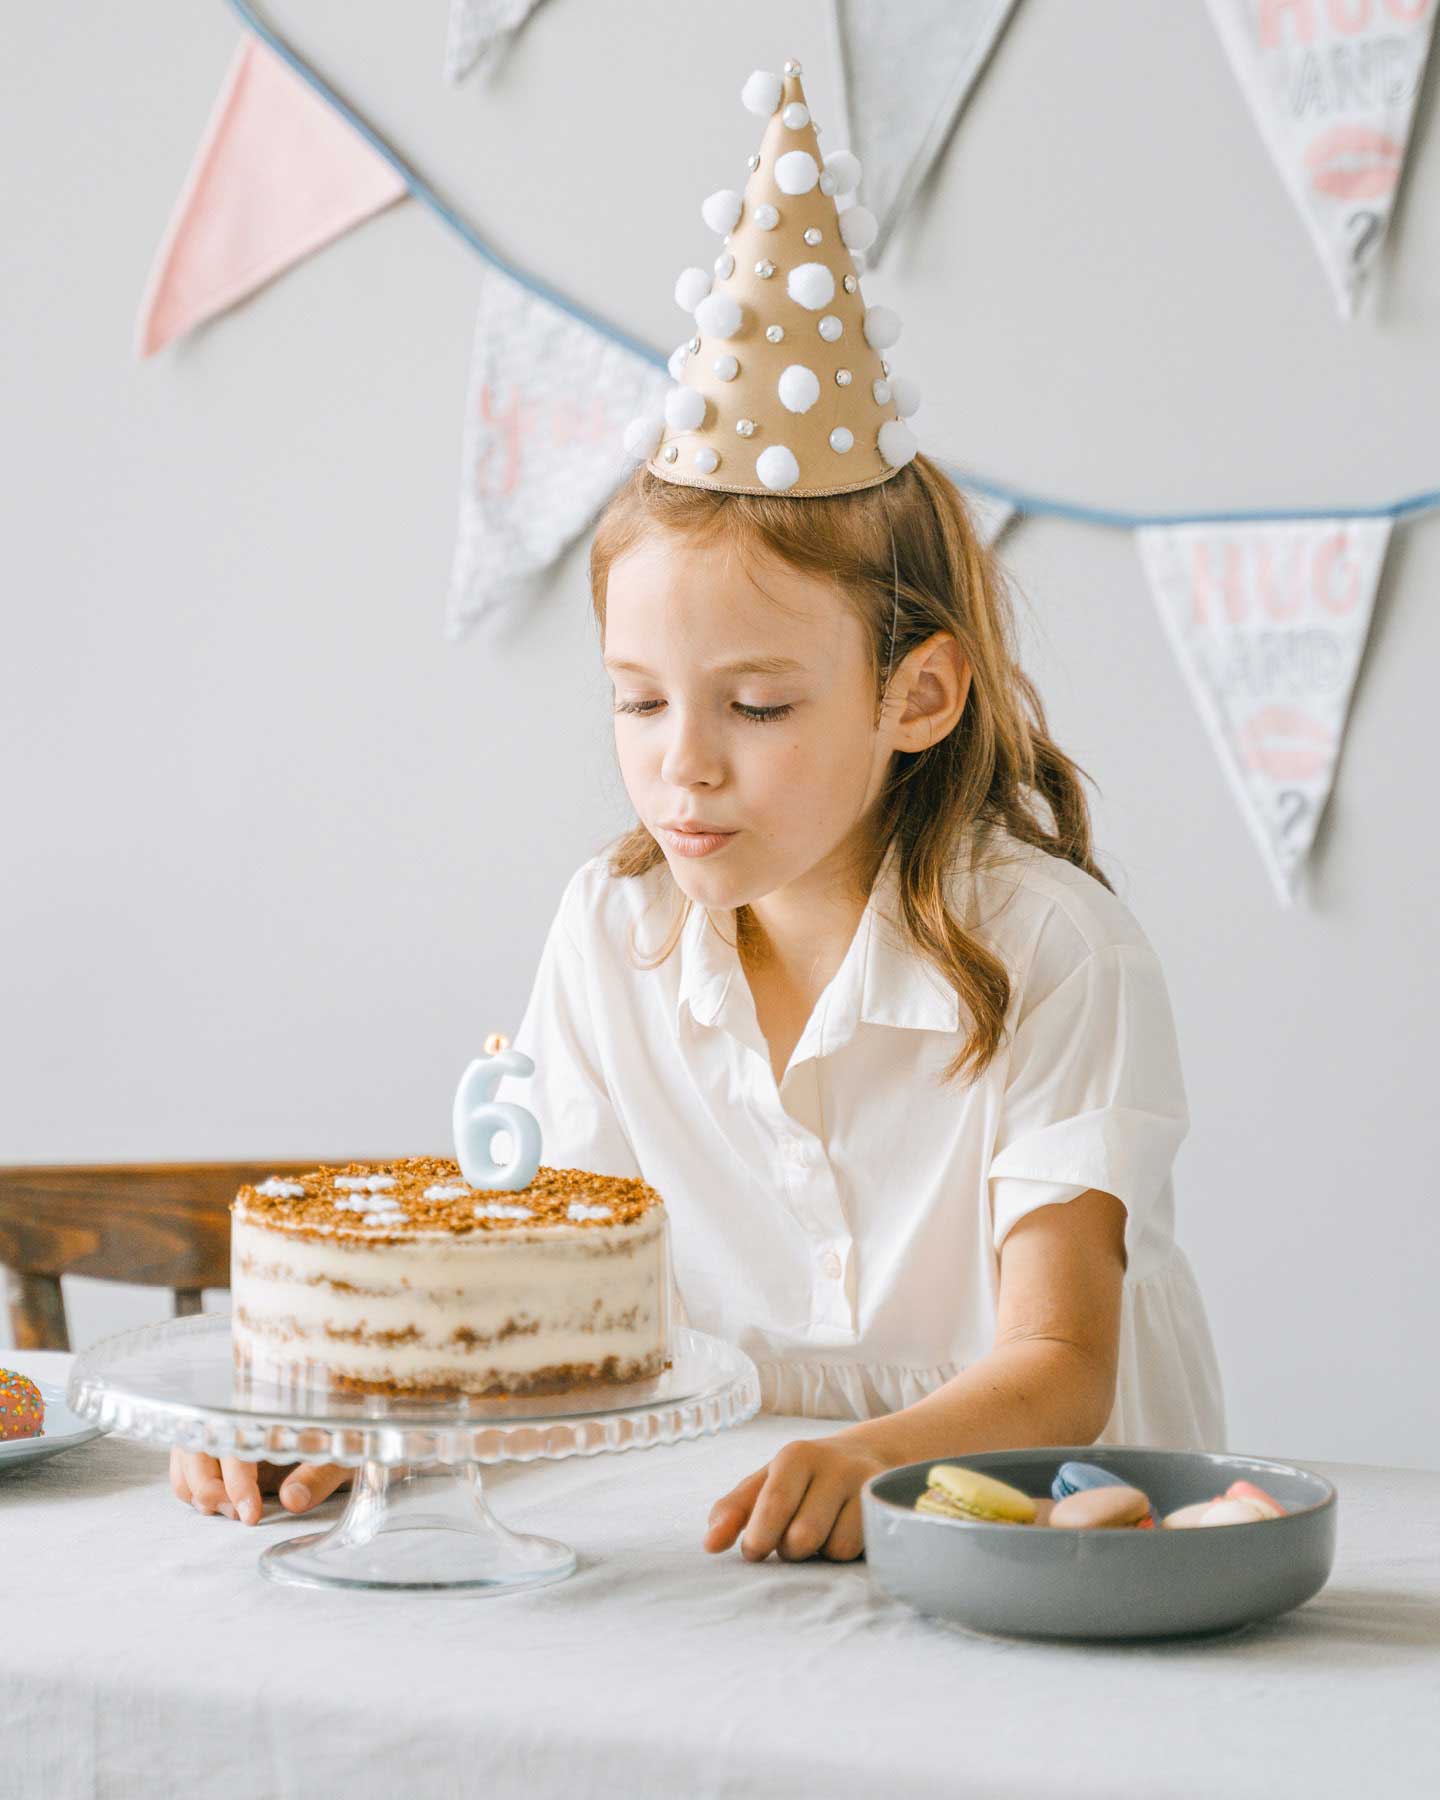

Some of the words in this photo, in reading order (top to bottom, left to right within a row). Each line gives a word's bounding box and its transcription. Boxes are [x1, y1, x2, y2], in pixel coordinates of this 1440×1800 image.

[1345, 210, 1383, 284] ?
[1193, 534, 1359, 624] HUG
[1276, 789, 1310, 859] ?
[453, 1049, 543, 1192] 6
